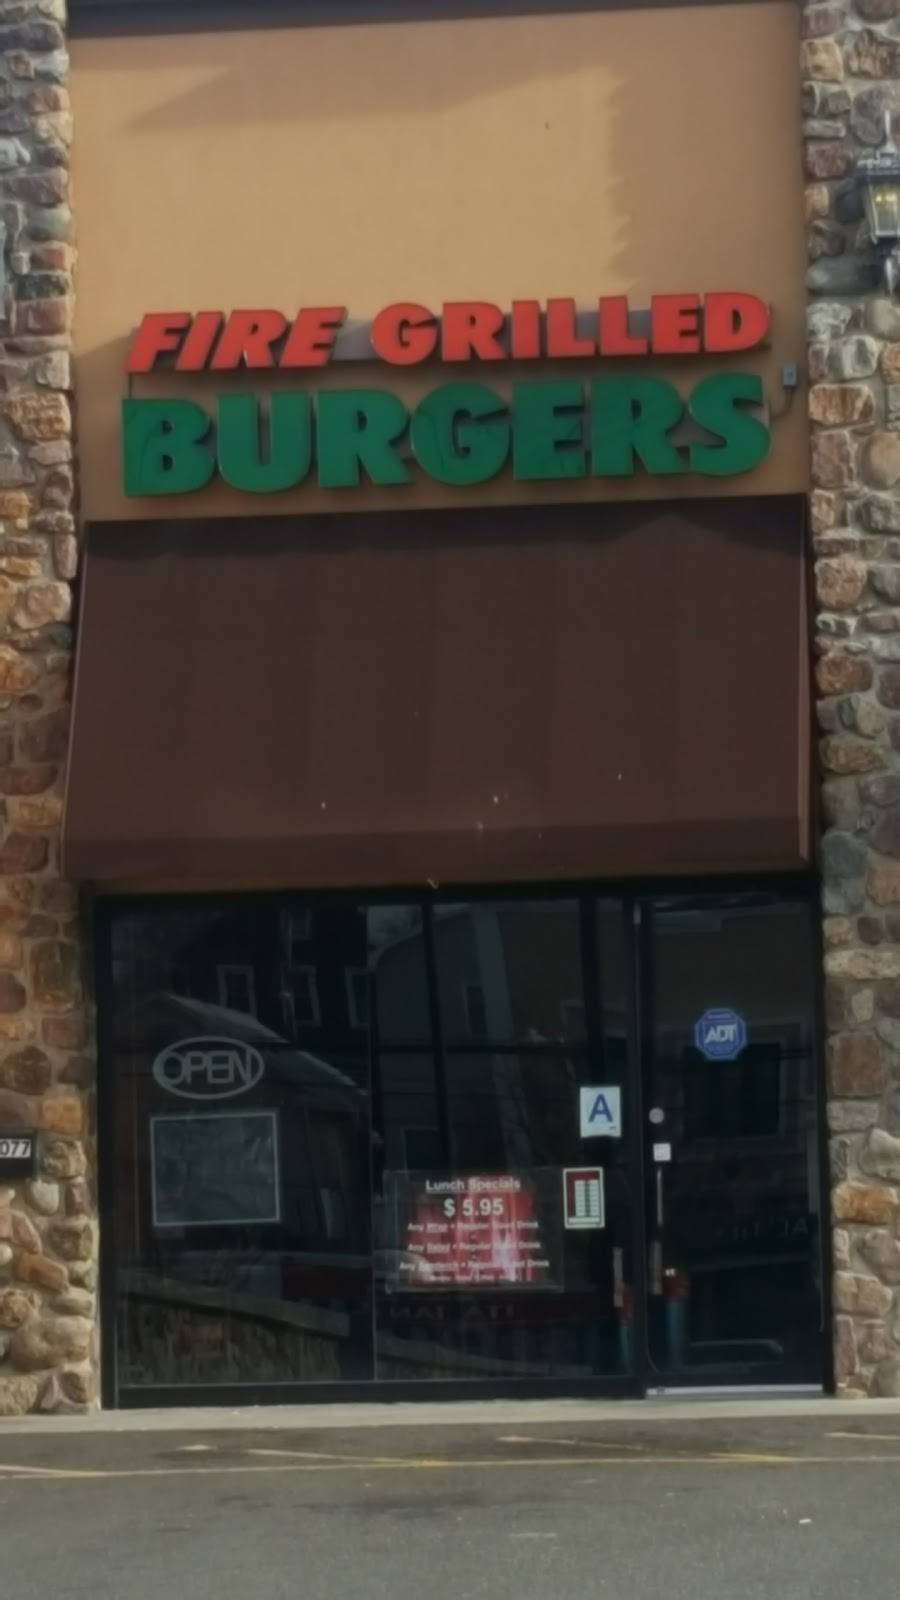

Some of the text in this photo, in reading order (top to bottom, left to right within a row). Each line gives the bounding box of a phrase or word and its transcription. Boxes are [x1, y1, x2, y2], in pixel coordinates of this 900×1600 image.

[127, 292, 770, 373] FIRE GRILLED
[121, 372, 771, 497] BURGERS
[703, 1024, 737, 1044] ADT
[162, 1049, 252, 1087] OPEN
[588, 1093, 614, 1124] A
[425, 1176, 521, 1193] Lunch Specials
[462, 1198, 504, 1217] 5.95
